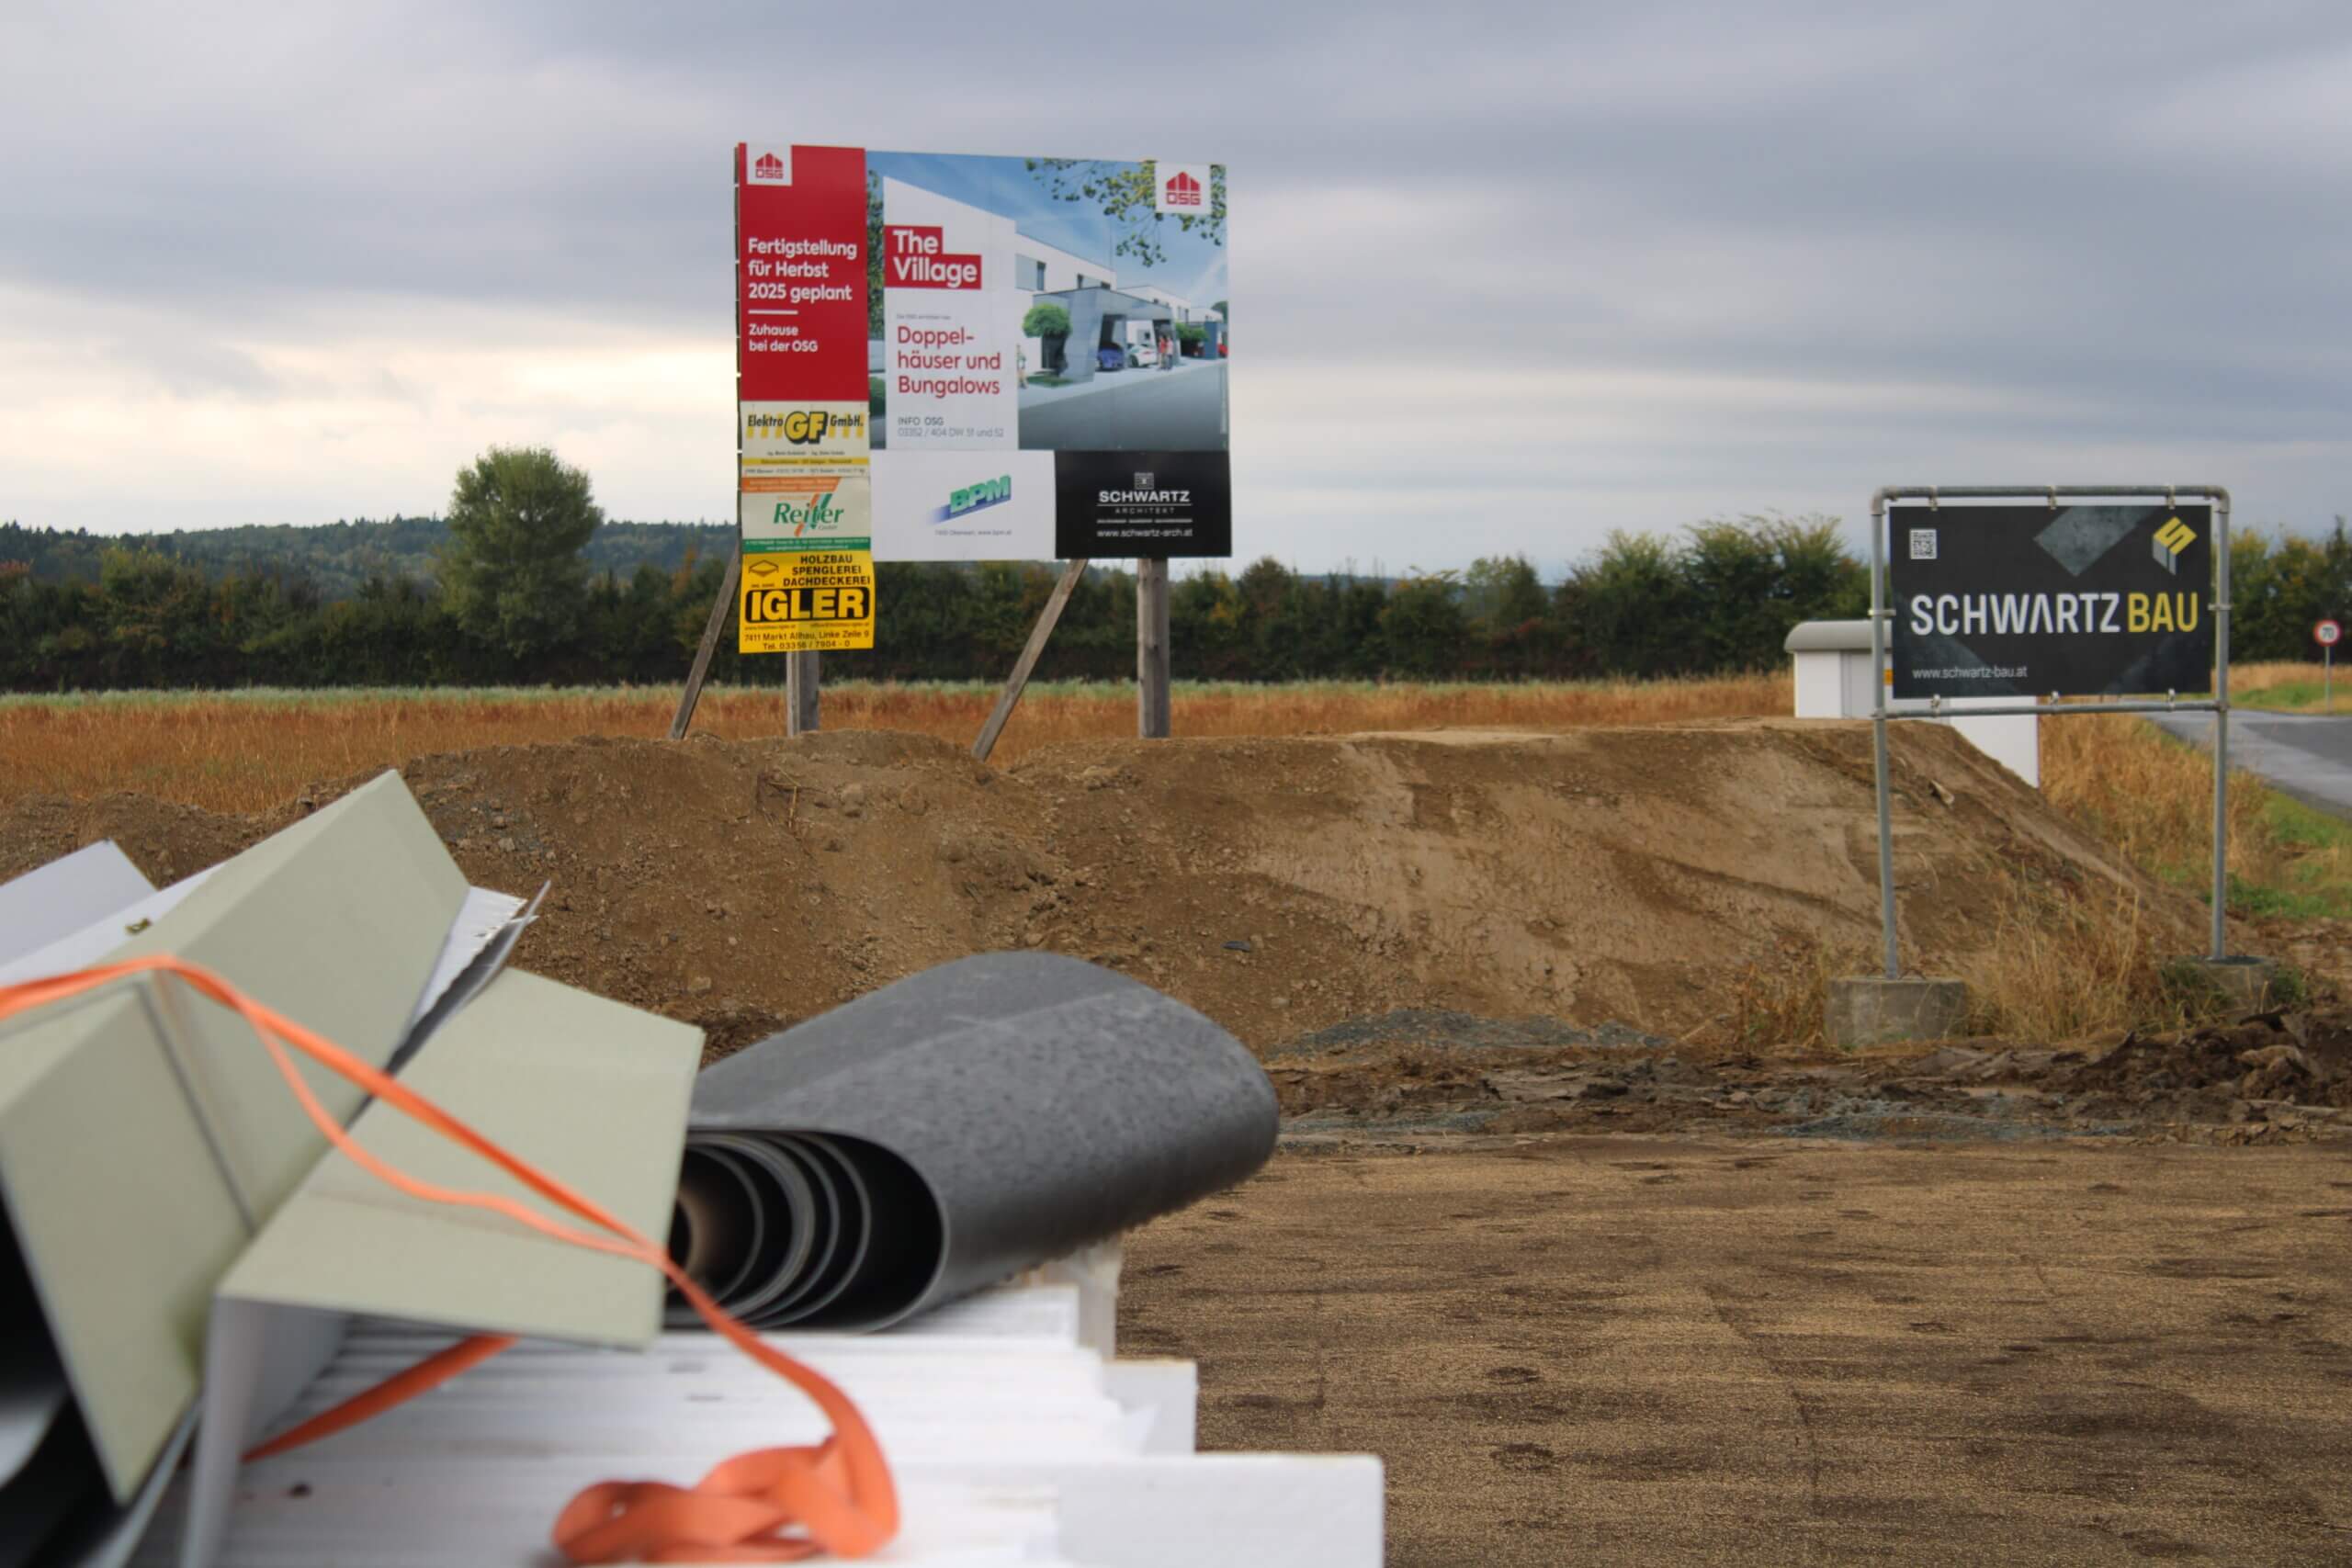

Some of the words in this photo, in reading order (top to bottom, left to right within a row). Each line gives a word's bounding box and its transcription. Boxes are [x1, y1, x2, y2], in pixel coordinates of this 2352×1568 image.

[1166, 193, 1201, 205] OSG
[748, 238, 857, 260] Fertigstellung
[893, 230, 939, 254] The
[748, 260, 772, 276] für
[775, 261, 830, 277] Herbst
[893, 257, 978, 288] Village
[748, 283, 787, 299] 2025
[790, 285, 853, 304] geplant
[749, 323, 798, 336] Zuhause
[897, 326, 974, 350] Doppel-
[749, 340, 768, 352] bei
[770, 340, 791, 352] der
[792, 340, 819, 352] OSG
[898, 350, 962, 369] häuser
[967, 353, 1001, 370] und
[898, 375, 1001, 398] Bungalows
[748, 414, 783, 427] Elektro
[785, 412, 829, 445] GF
[898, 416, 921, 426] INFO
[924, 416, 944, 426] OSG
[950, 475, 1012, 513] BPM
[1099, 491, 1190, 502] SCHWARTZ
[774, 497, 843, 527] Reiter
[1097, 528, 1193, 537] www.schwartz-arch.at
[800, 555, 853, 564] HOLZBAU
[792, 565, 861, 575] SPENGLEREI
[783, 576, 870, 587] DACHDECKEREI
[751, 589, 864, 621] IGLER
[1911, 593, 2120, 636] SCHWARTZ
[2128, 592, 2198, 633] BAU
[763, 632, 787, 640] Markt
[819, 631, 840, 639] Linke
[842, 630, 862, 638] Zeile
[2322, 627, 2334, 638] 70
[1913, 665, 2028, 680] www.schwartz-bau.at
